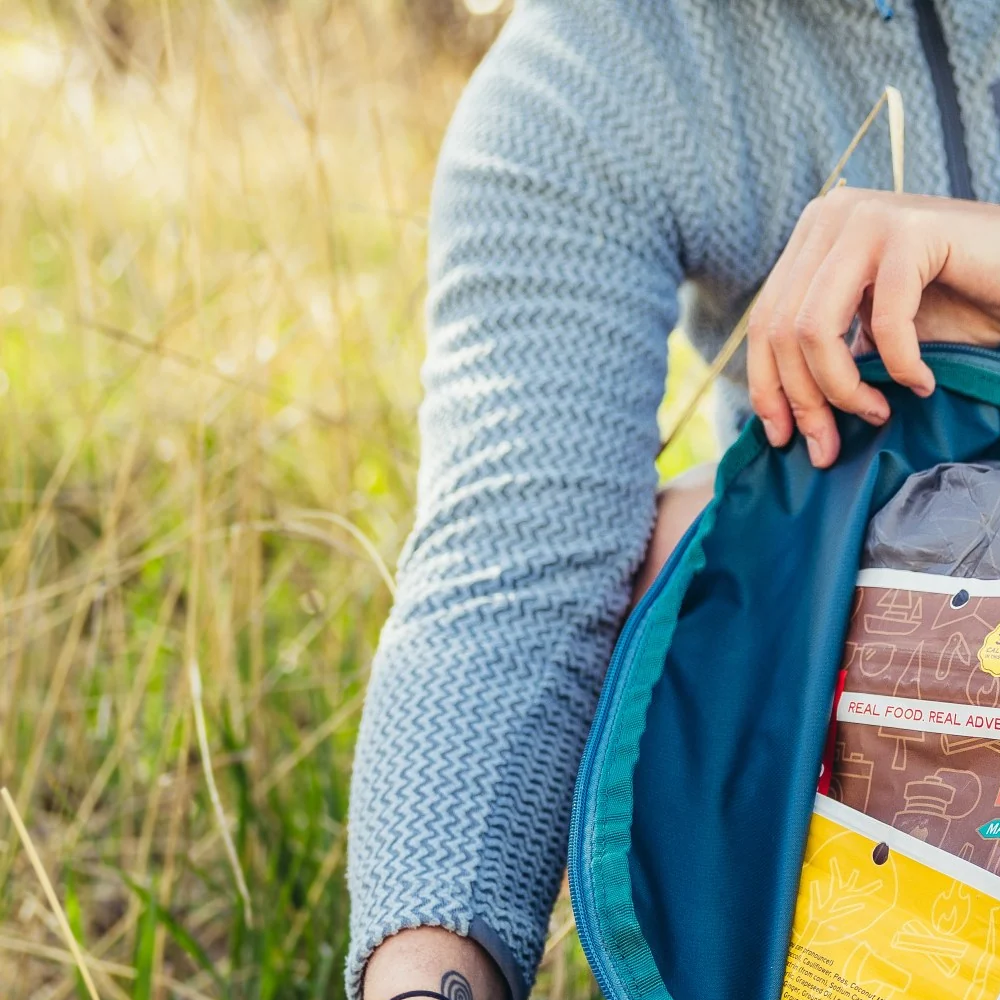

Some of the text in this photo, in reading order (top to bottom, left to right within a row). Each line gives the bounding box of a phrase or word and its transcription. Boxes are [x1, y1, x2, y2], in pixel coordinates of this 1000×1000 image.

[848, 702, 880, 716] REAL
[885, 706, 924, 722] FOOD.
[929, 710, 961, 726] REAL
[795, 975, 823, 994] Grapeseed
[828, 981, 850, 997] Sodium
[849, 982, 876, 1000] Coconut
